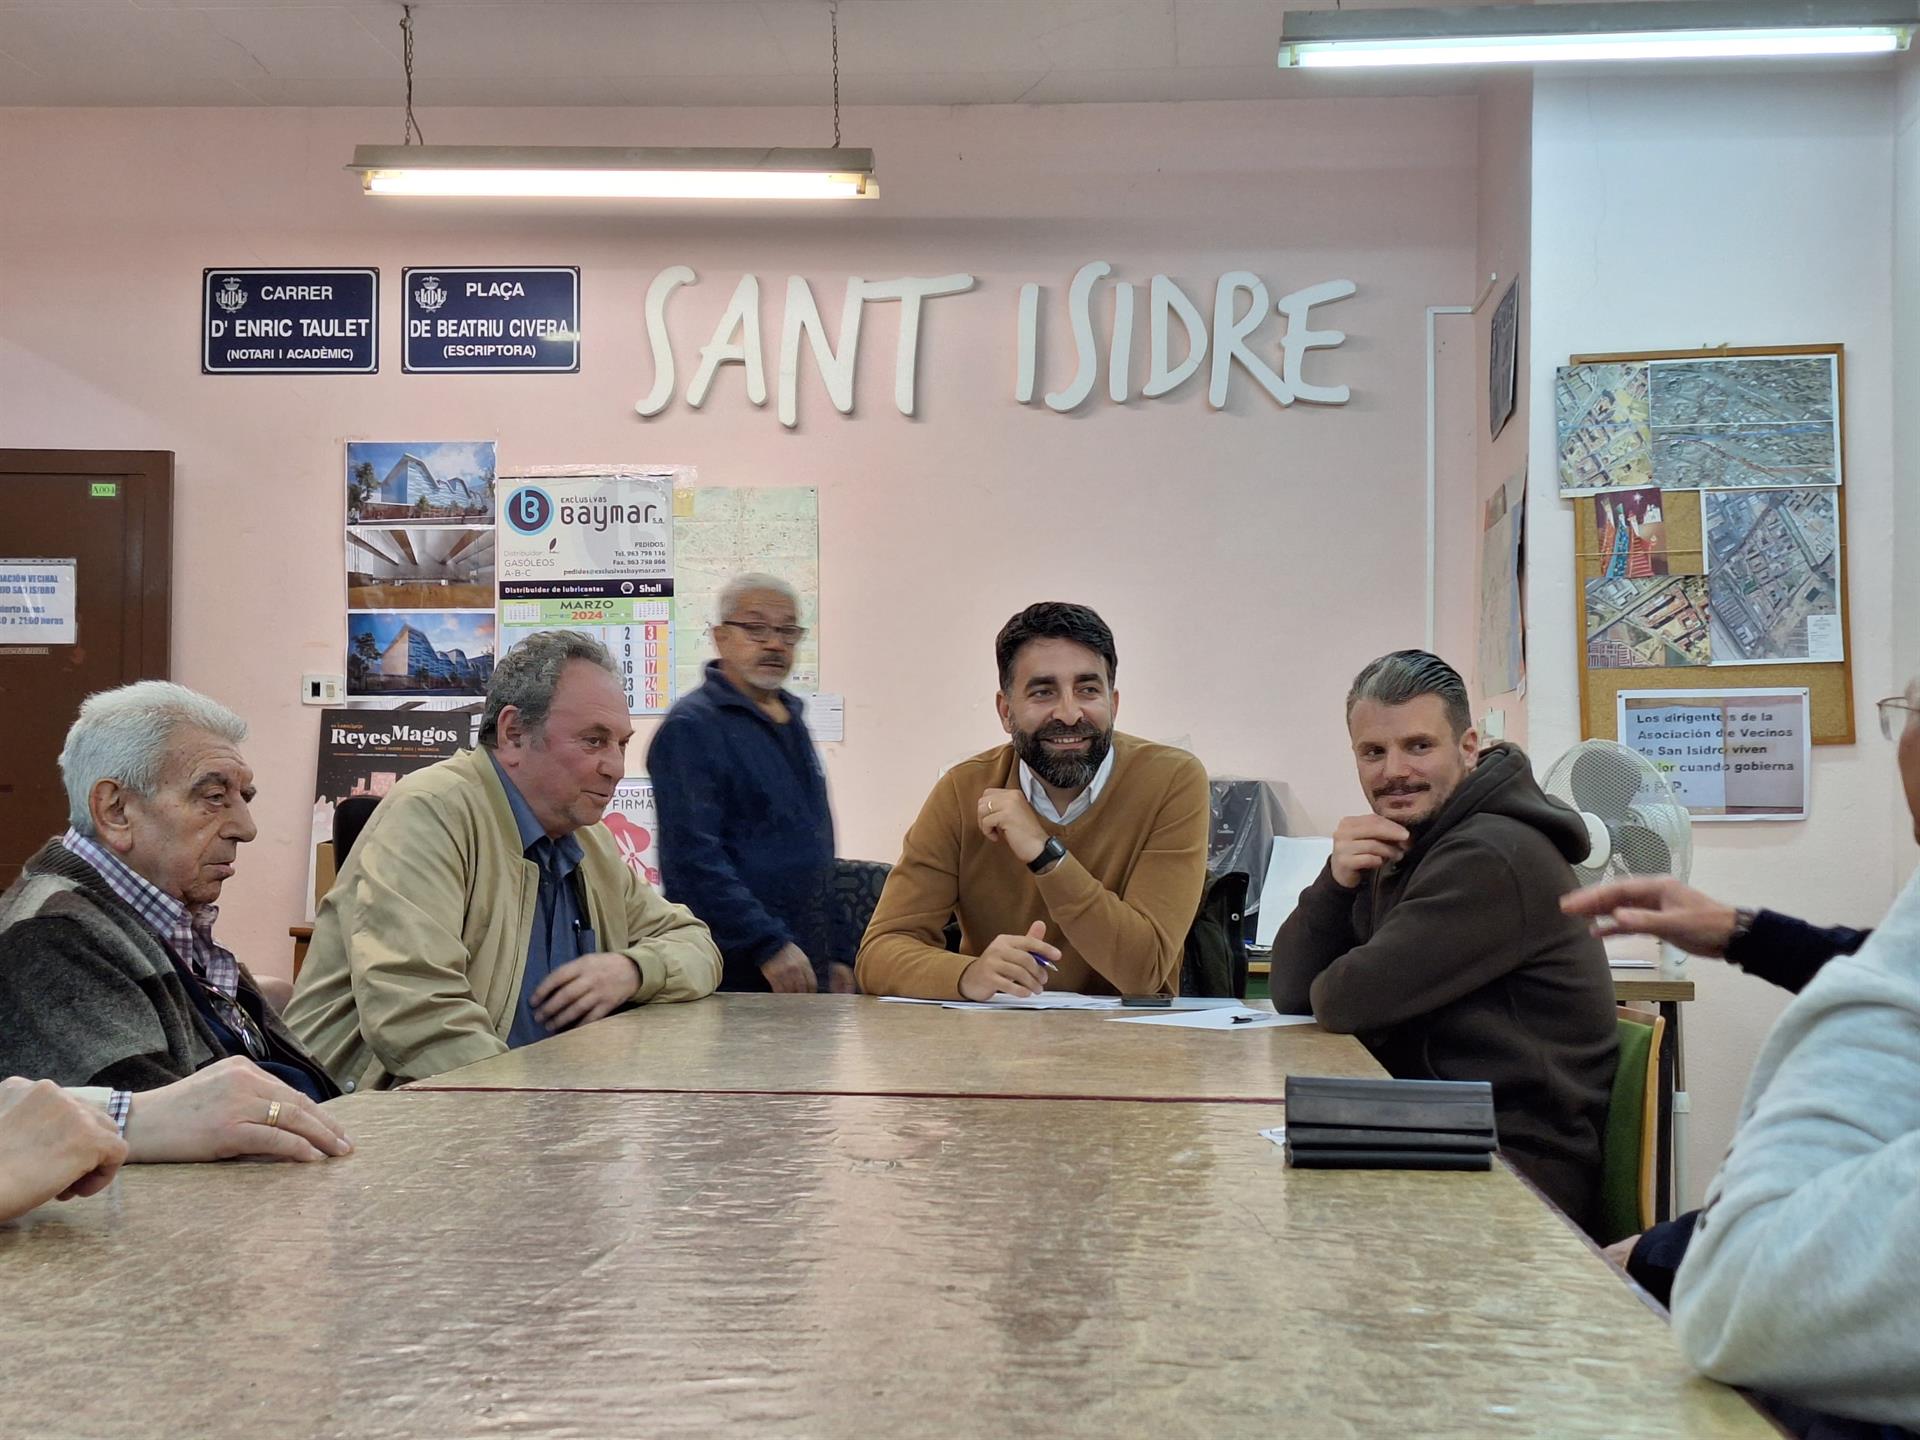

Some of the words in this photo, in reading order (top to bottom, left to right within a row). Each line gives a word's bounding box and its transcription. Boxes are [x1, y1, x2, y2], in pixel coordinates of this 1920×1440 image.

[260, 285, 333, 301] CARRER
[466, 282, 525, 301] PLAÇA
[211, 319, 228, 337] D'
[235, 319, 292, 337] ENRIC
[300, 319, 369, 337] TAULET
[410, 319, 431, 337] DE
[437, 319, 504, 337] BEATRIU
[509, 319, 570, 337] CIVERA
[634, 265, 974, 427] SANT
[1015, 260, 1357, 412] ISIDRE
[226, 348, 275, 361] (NOTARI
[279, 349, 283, 359] I
[286, 346, 354, 361] ACADÈMIC)
[443, 345, 536, 358] (ESCRIPTORA)
[560, 504, 657, 532] Baymar
[504, 558, 555, 567] GASÓLEOS
[504, 569, 532, 577] A-B-C
[504, 586, 550, 594] Distribuidor
[562, 585, 604, 593] lubricantes
[639, 584, 662, 593] Shell
[560, 600, 614, 609] MARZO
[571, 611, 604, 620] 2024
[624, 626, 631, 640] 2
[647, 626, 654, 640] 3
[624, 643, 631, 657] 9
[646, 643, 656, 657] 10
[622, 661, 633, 674] 16
[646, 660, 656, 674] 17
[645, 677, 657, 691] 24
[646, 694, 657, 708] 31
[1637, 714, 1660, 723] Los
[1741, 712, 1757, 722] de
[1761, 712, 1773, 721] la
[331, 728, 391, 749] Reyes
[391, 725, 458, 746] Magos
[1638, 730, 1711, 740] Asociación
[1740, 728, 1793, 738] Vecinos
[1658, 746, 1682, 756] San
[1687, 744, 1727, 756] Isidro
[1732, 744, 1768, 754] viven
[1679, 763, 1730, 772] cuando
[1734, 762, 1794, 773] gobierna
